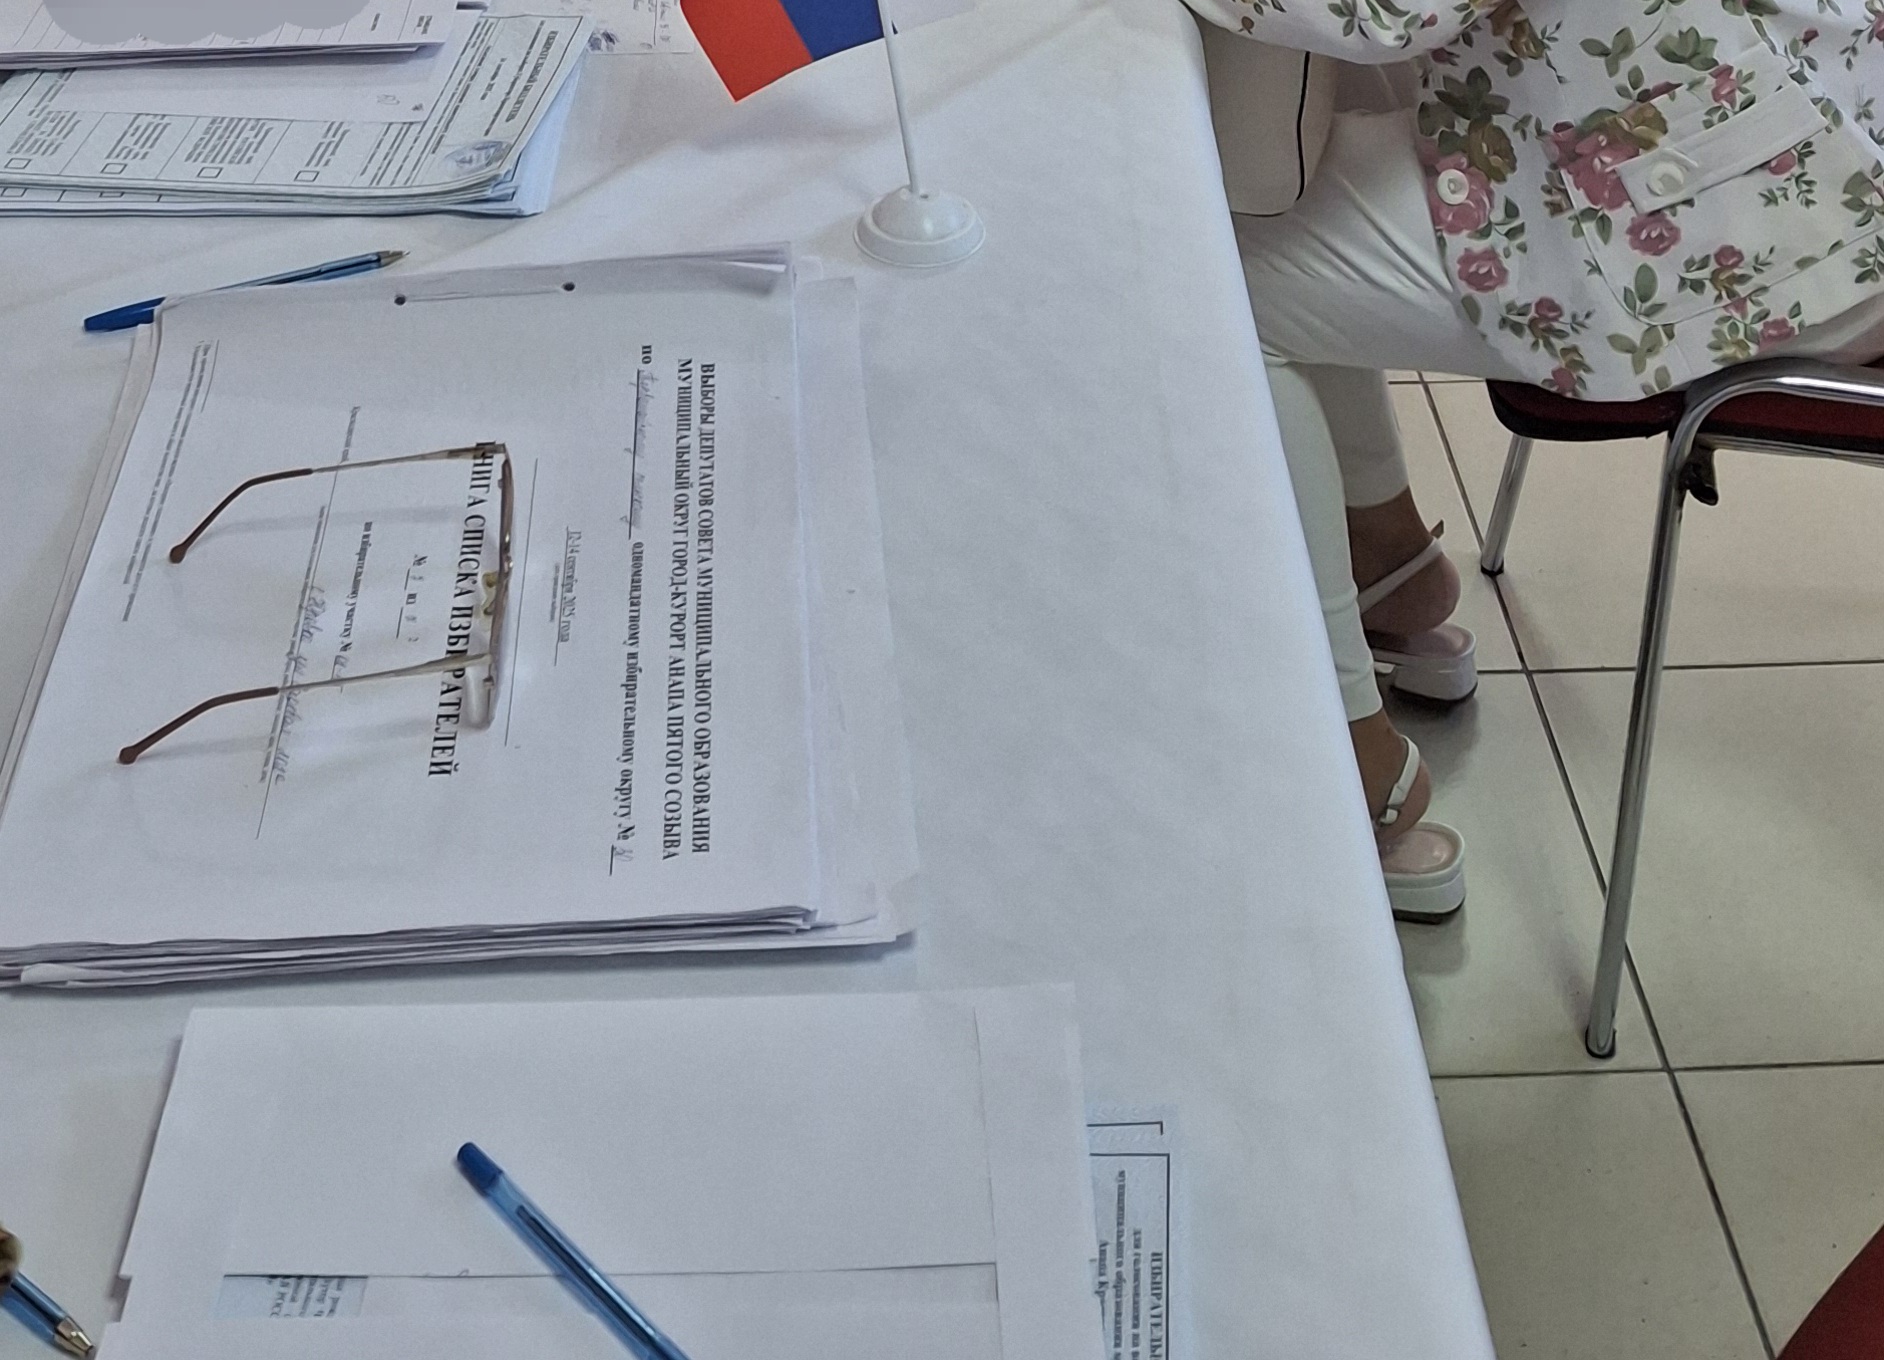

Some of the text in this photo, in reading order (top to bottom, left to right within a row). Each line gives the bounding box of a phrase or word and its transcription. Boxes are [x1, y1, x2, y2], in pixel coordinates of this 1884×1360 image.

[641, 344, 653, 365] по
[453, 514, 487, 599] СПИСКА
[623, 541, 645, 648] одномандатному
[662, 358, 694, 861] МУНИЦИПАЛЬНЫЙ ОКРУГ ГОРОД-КУРОРТ АНАПА ПЯТОГО СОЗЫВА
[692, 363, 716, 854] ВЫБОРЫ ДЕПУТАТОВ СОВЕТА МУНИЦИПАЛЬНОГО ОБРАЗОВАНИЯ
[616, 652, 643, 765] избирательному
[613, 769, 634, 820] округу
[617, 823, 636, 841] №
